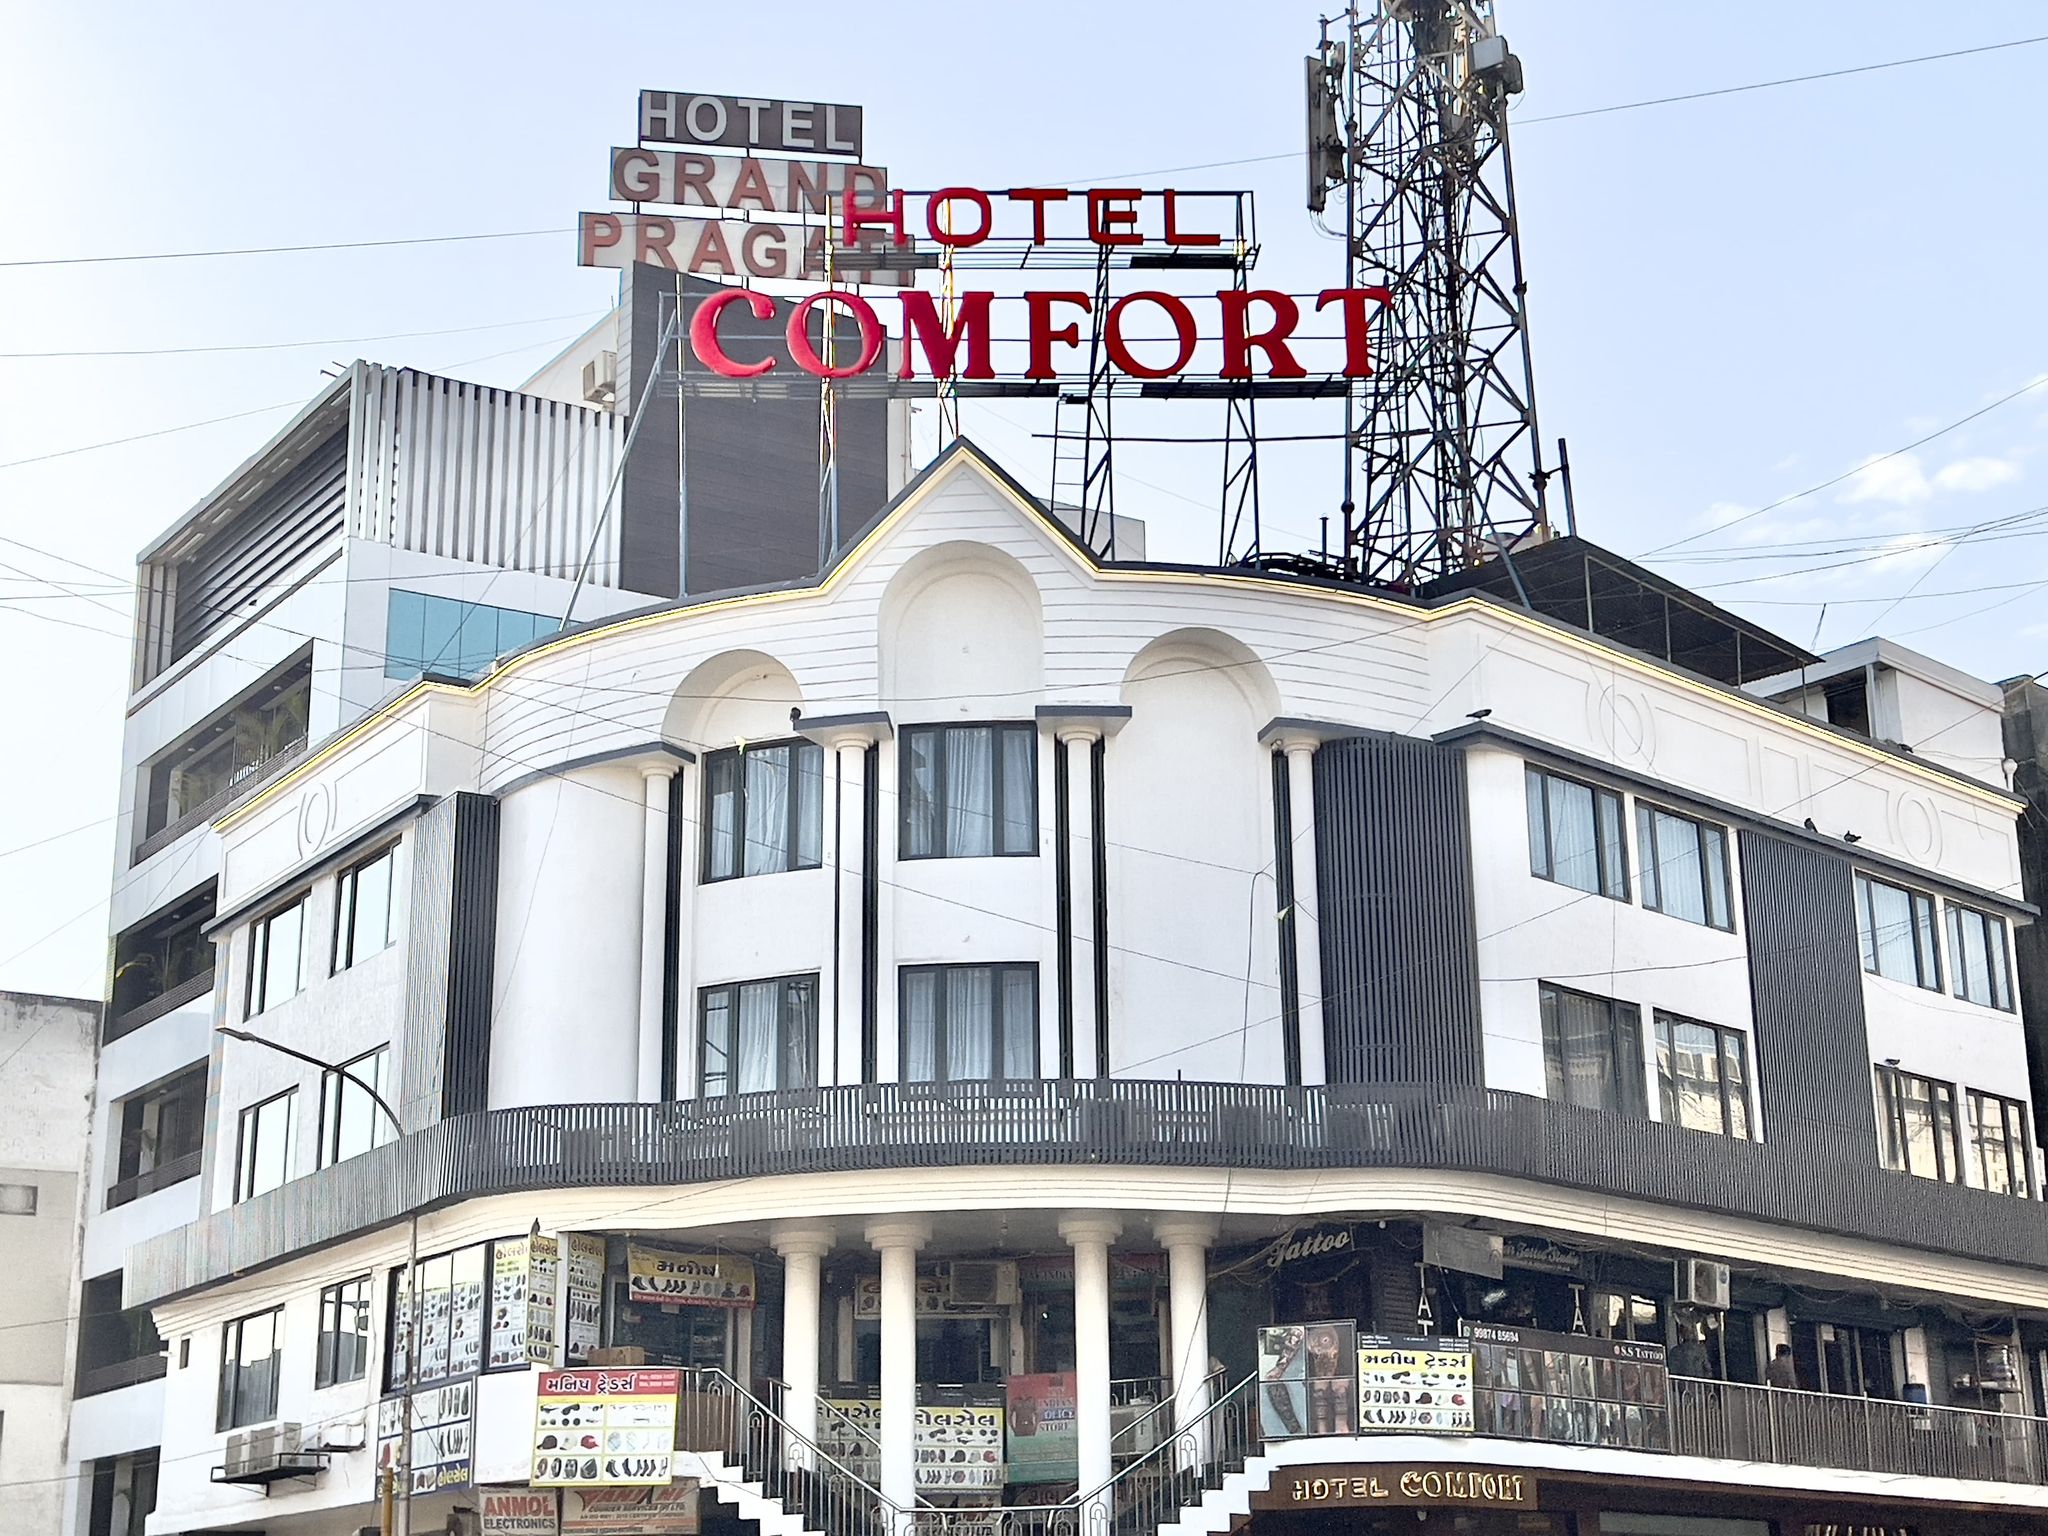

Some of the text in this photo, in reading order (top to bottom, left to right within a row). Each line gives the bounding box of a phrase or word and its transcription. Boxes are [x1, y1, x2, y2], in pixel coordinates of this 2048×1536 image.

[641, 91, 855, 151] HOTEL
[612, 149, 886, 215] GRAND
[843, 188, 1222, 247] HOTEL
[689, 288, 1394, 380] COMFORT
[1266, 1231, 1350, 1267] Tattoo
[1042, 1409, 1075, 1420] OLICE
[483, 1496, 556, 1518] ANMOL
[1292, 1477, 1390, 1501] HOTEL
[483, 1517, 556, 1530] ELECTRONICS
